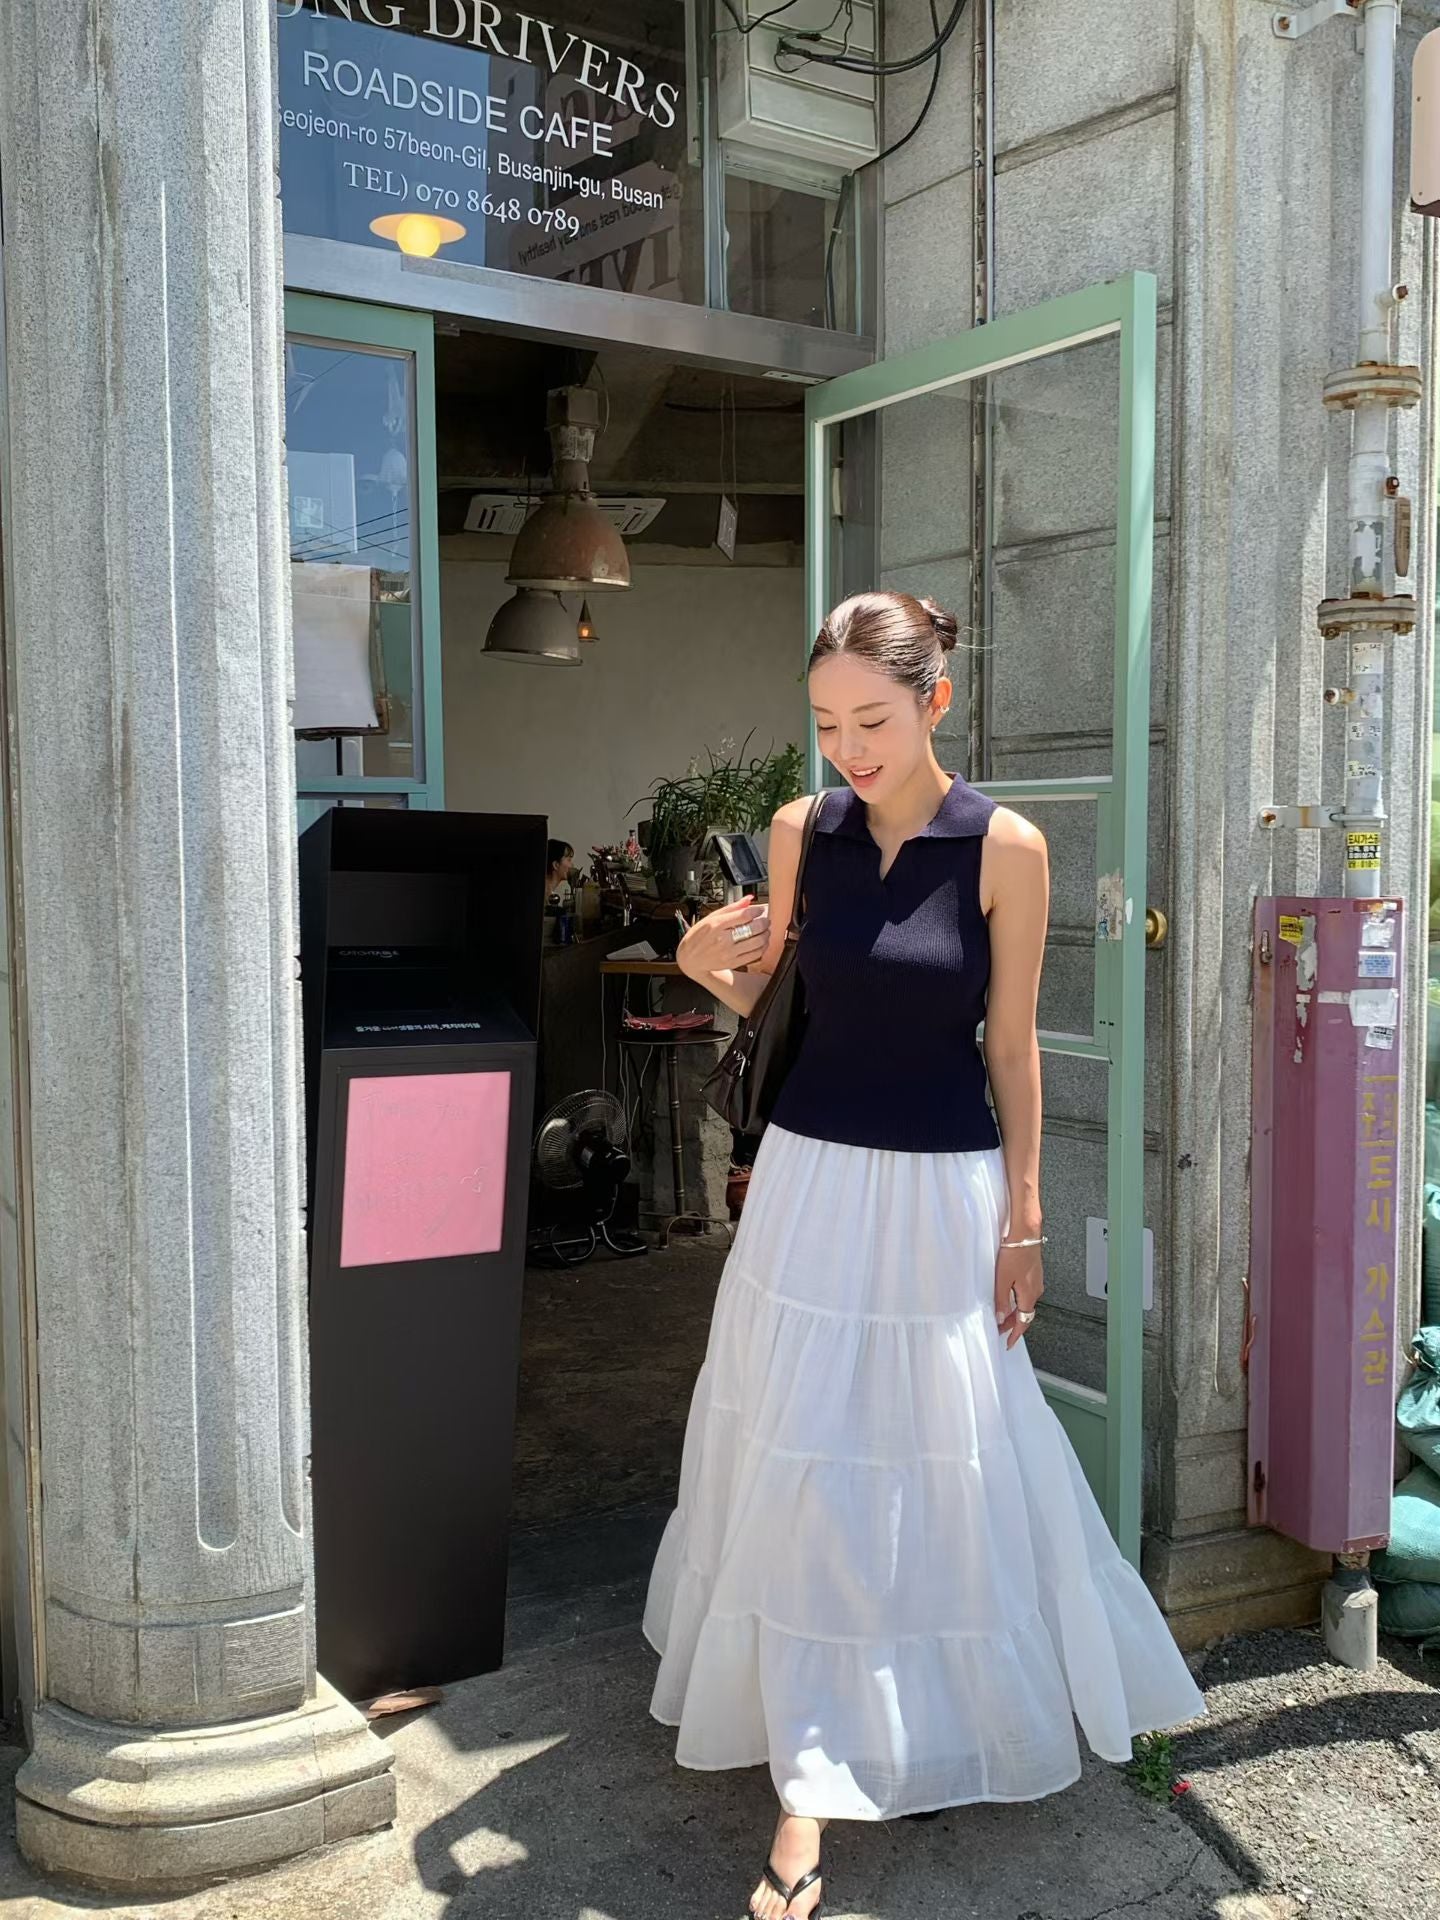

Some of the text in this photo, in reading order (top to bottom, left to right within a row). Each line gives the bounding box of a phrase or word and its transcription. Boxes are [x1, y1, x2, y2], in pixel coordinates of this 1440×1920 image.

[303, 50, 508, 133] ROADSIDE
[519, 105, 614, 158] CAFE
[423, 0, 679, 129] DRIVERS
[281, 108, 664, 210] eojeon-ro 57beon-Gil, Busanjin-gu, Busan
[342, 161, 580, 238] TEL) 070 8648 0789
